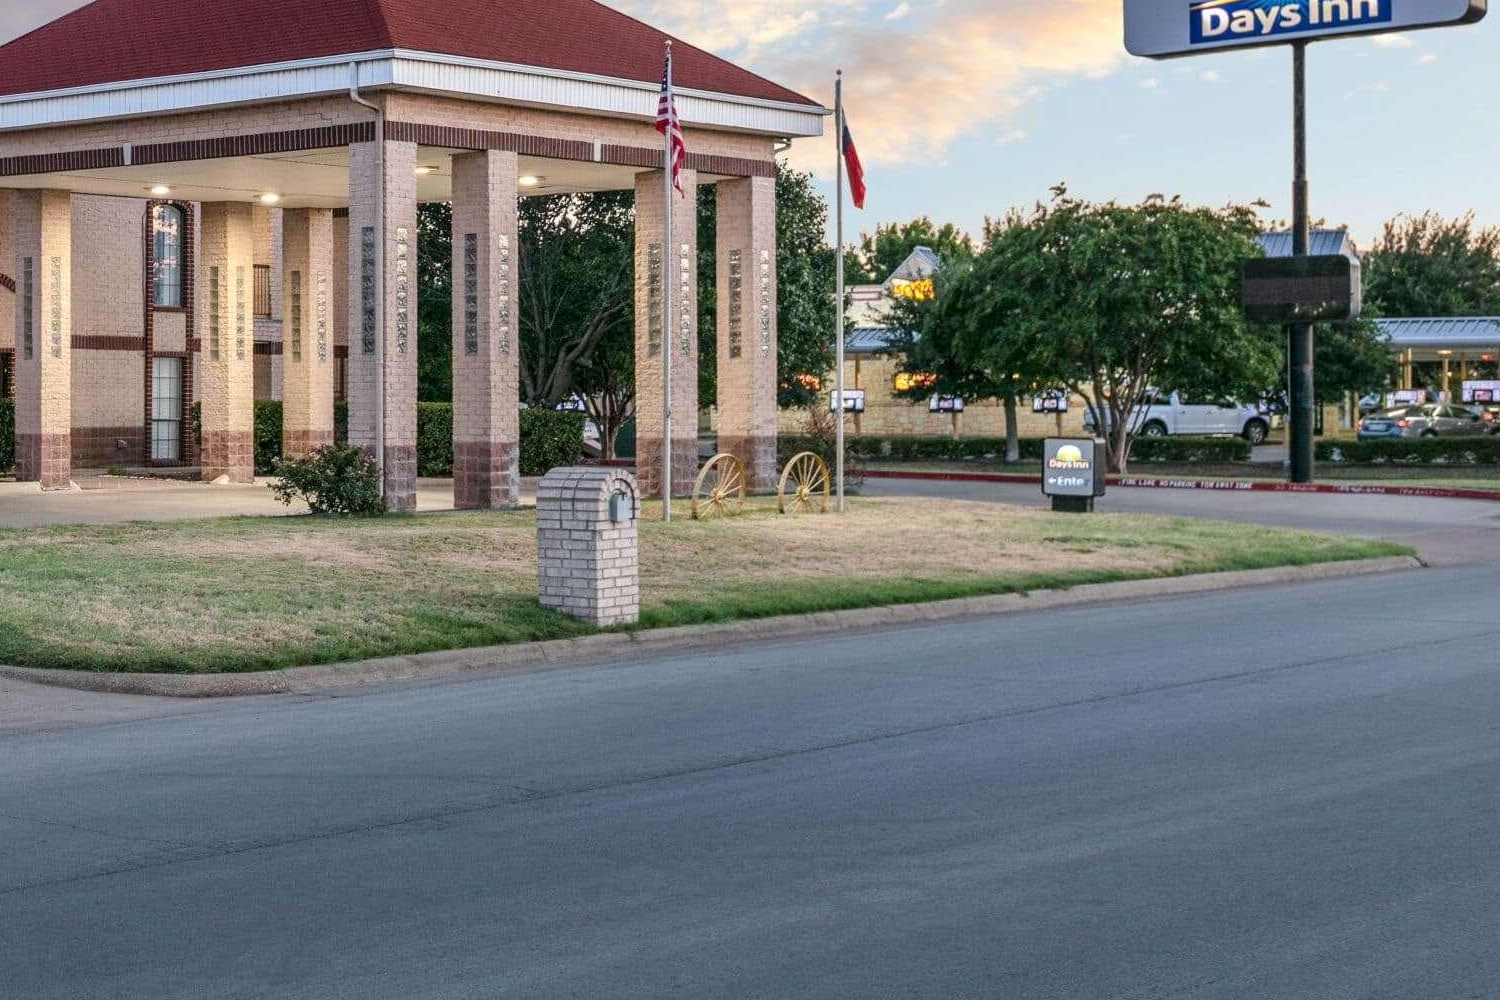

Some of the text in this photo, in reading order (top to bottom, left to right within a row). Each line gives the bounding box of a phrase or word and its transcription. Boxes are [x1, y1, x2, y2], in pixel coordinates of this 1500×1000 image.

[1201, 3, 1301, 37] Days
[1049, 459, 1089, 469] Days Inn
